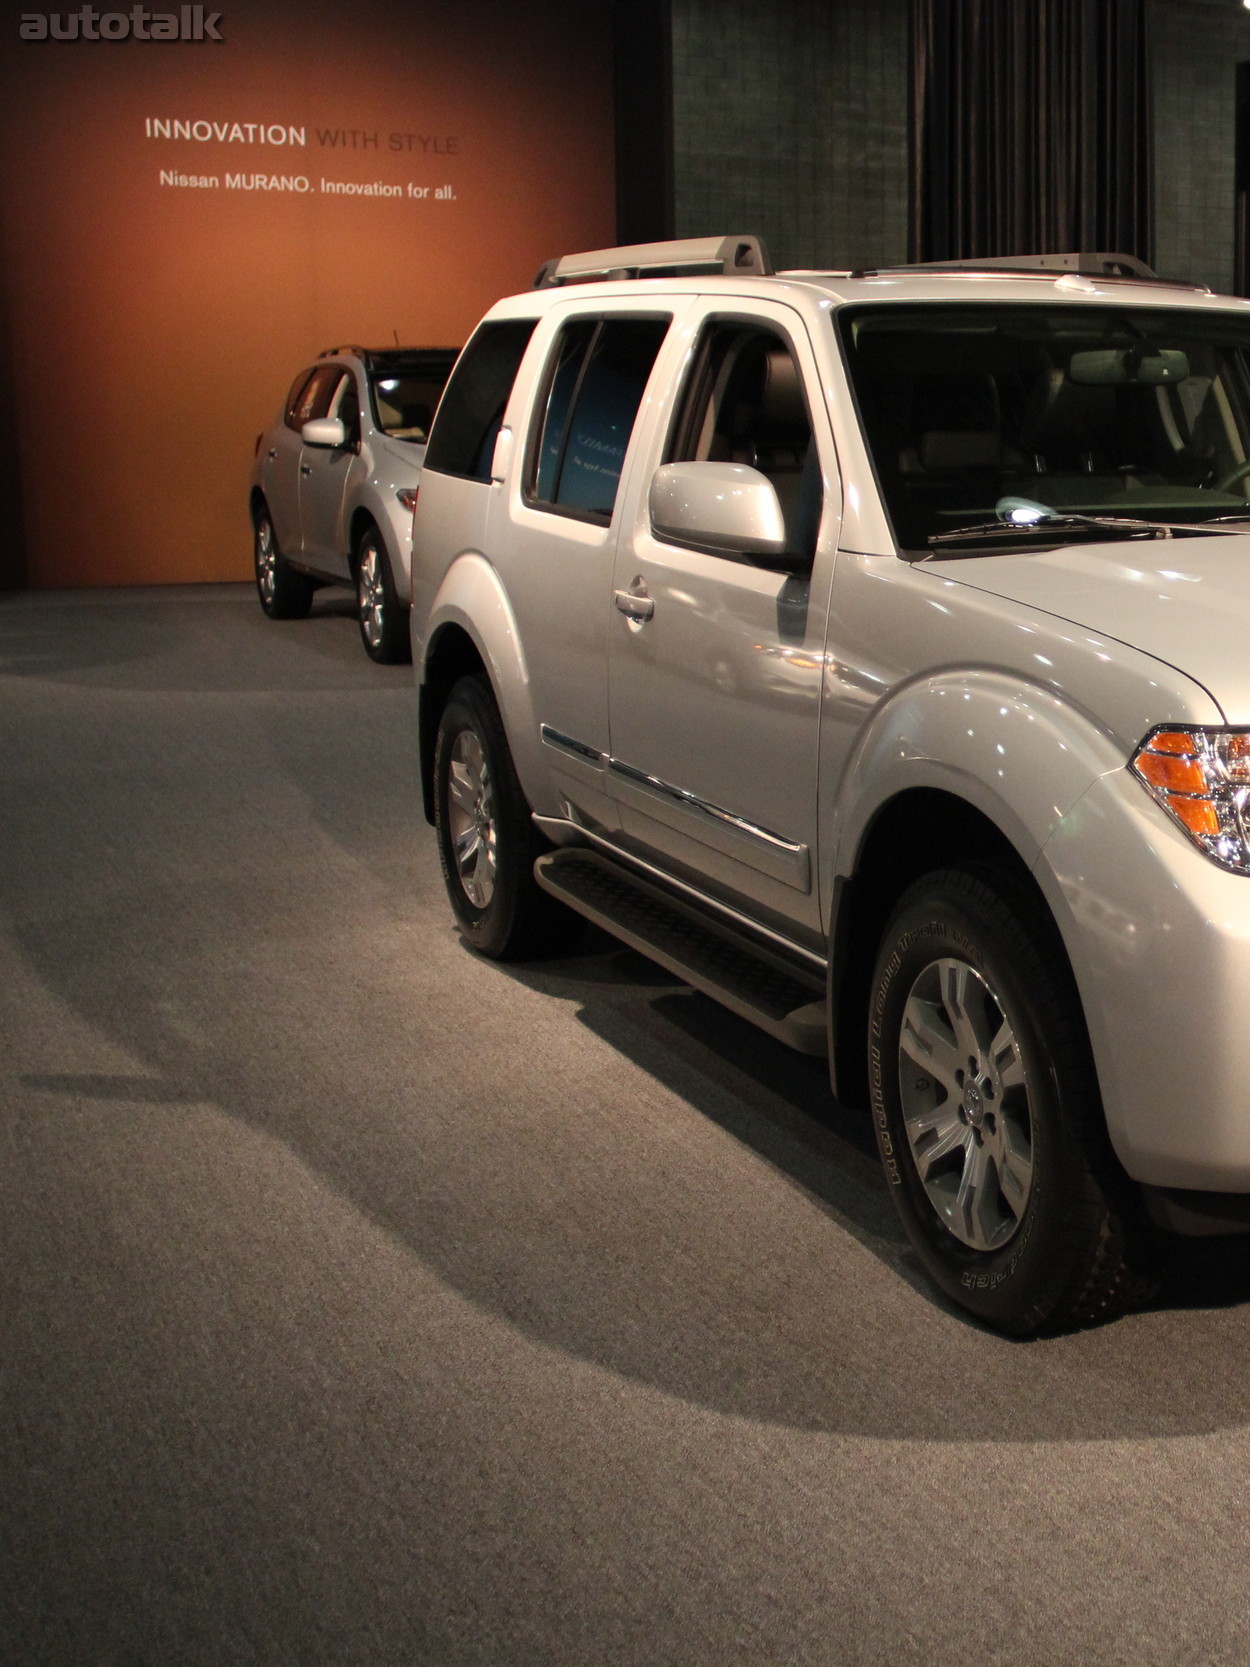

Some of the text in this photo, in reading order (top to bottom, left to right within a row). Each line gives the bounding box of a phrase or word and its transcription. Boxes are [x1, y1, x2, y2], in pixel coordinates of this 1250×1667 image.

[145, 117, 460, 155] INNOVATION WITH STYLE
[159, 169, 457, 200] Nissan MURANO. Innovation for all.
[871, 1046, 901, 1185] Radial
[898, 920, 947, 952] Trail
